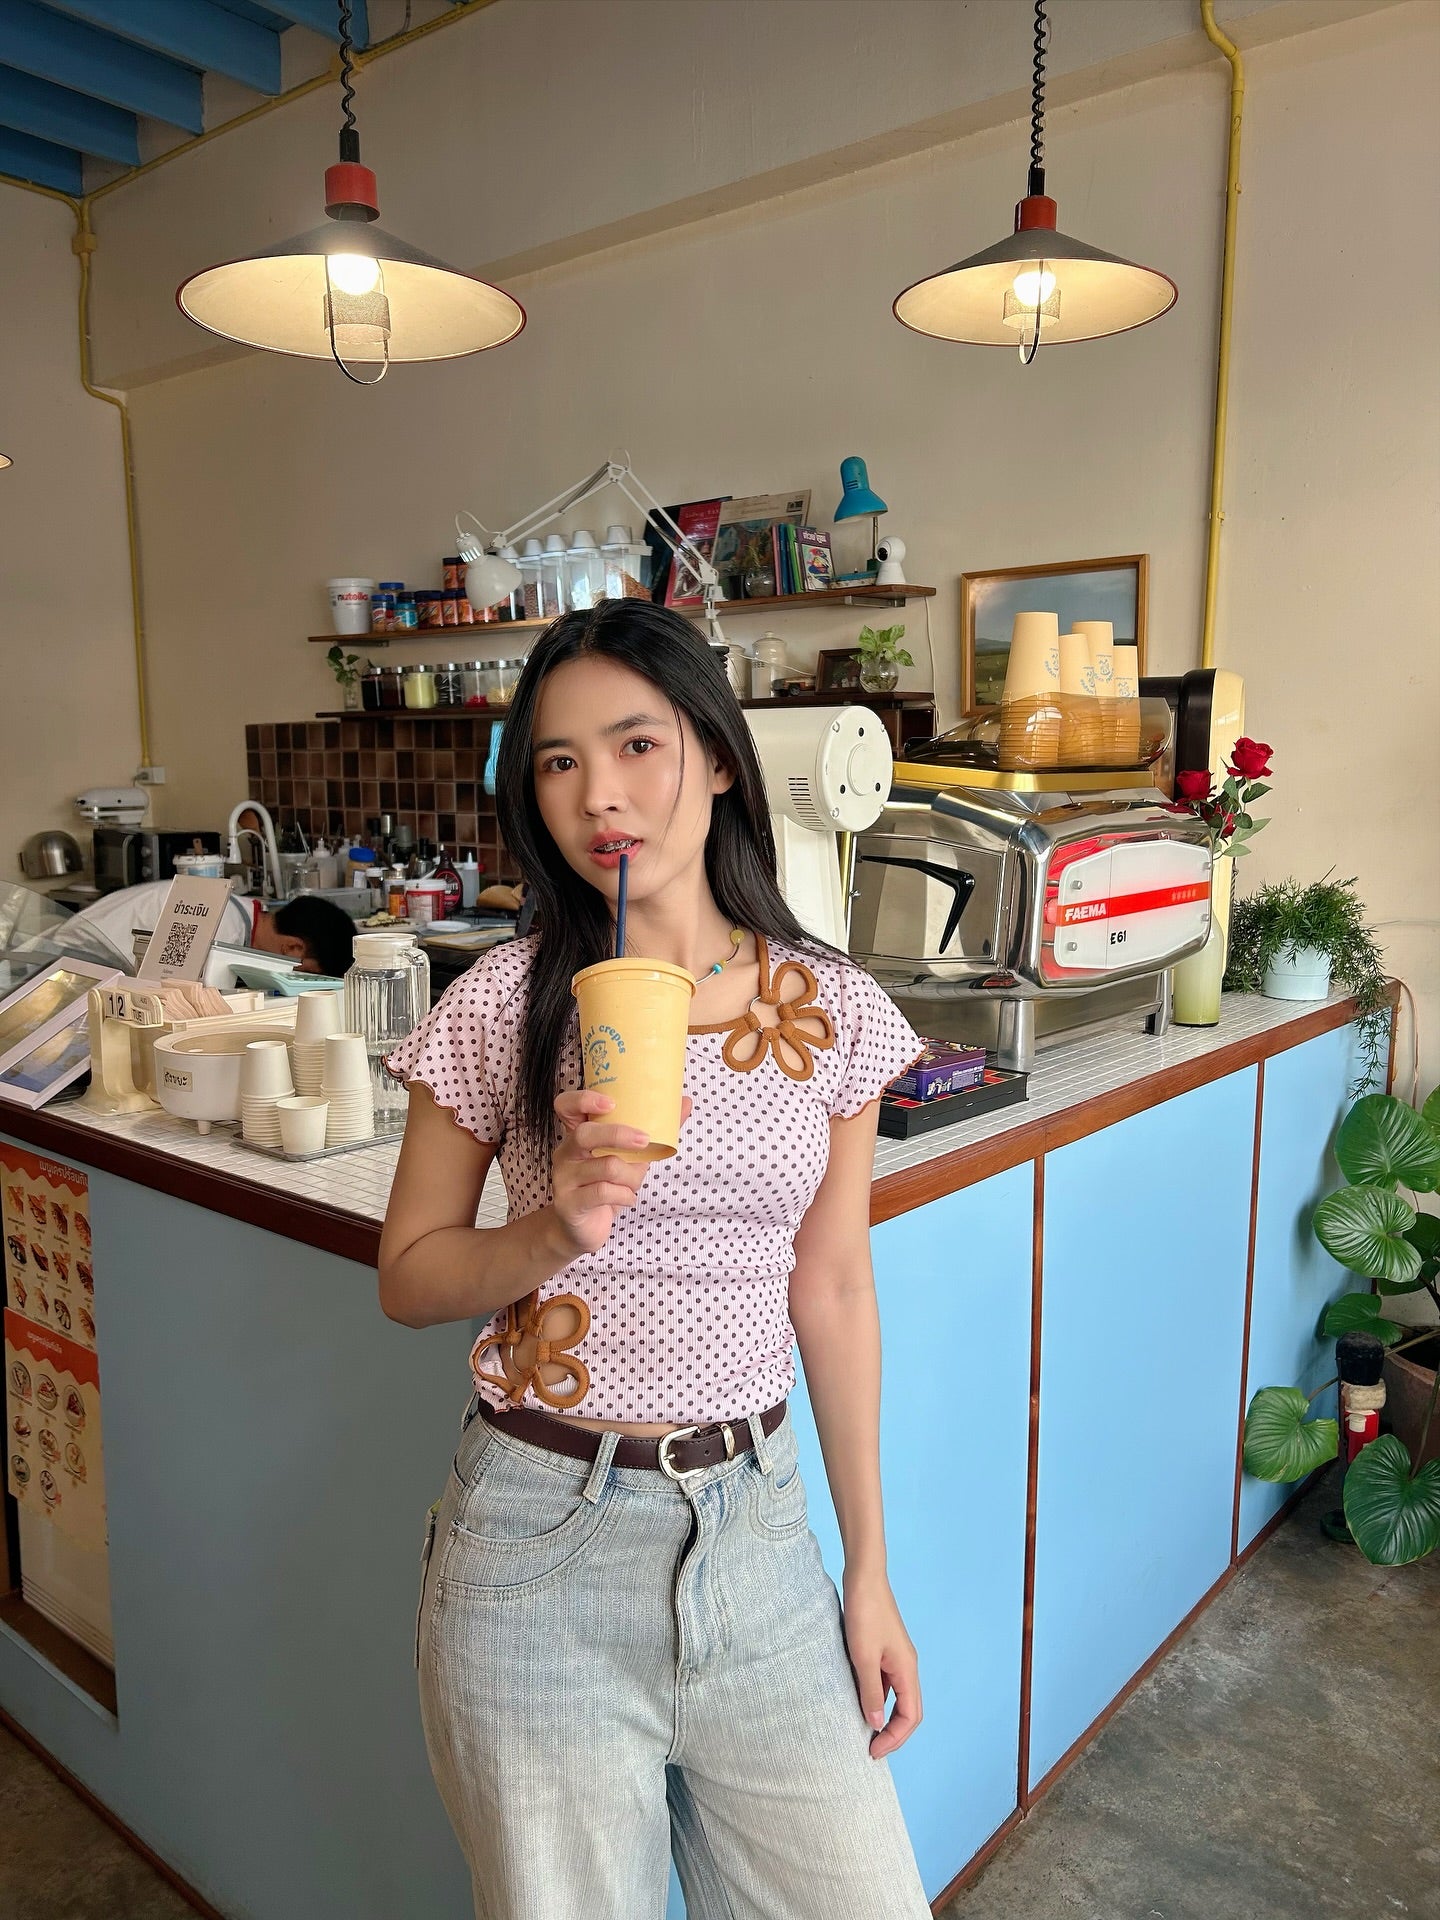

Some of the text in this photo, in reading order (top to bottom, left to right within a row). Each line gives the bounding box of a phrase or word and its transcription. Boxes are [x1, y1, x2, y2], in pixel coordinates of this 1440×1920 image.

[1065, 902, 1107, 922] FAEMA
[1110, 929, 1127, 945] E61
[108, 993, 125, 1017] 12
[131, 1008, 142, 1022] TUE
[598, 1024, 626, 1054] crepes
